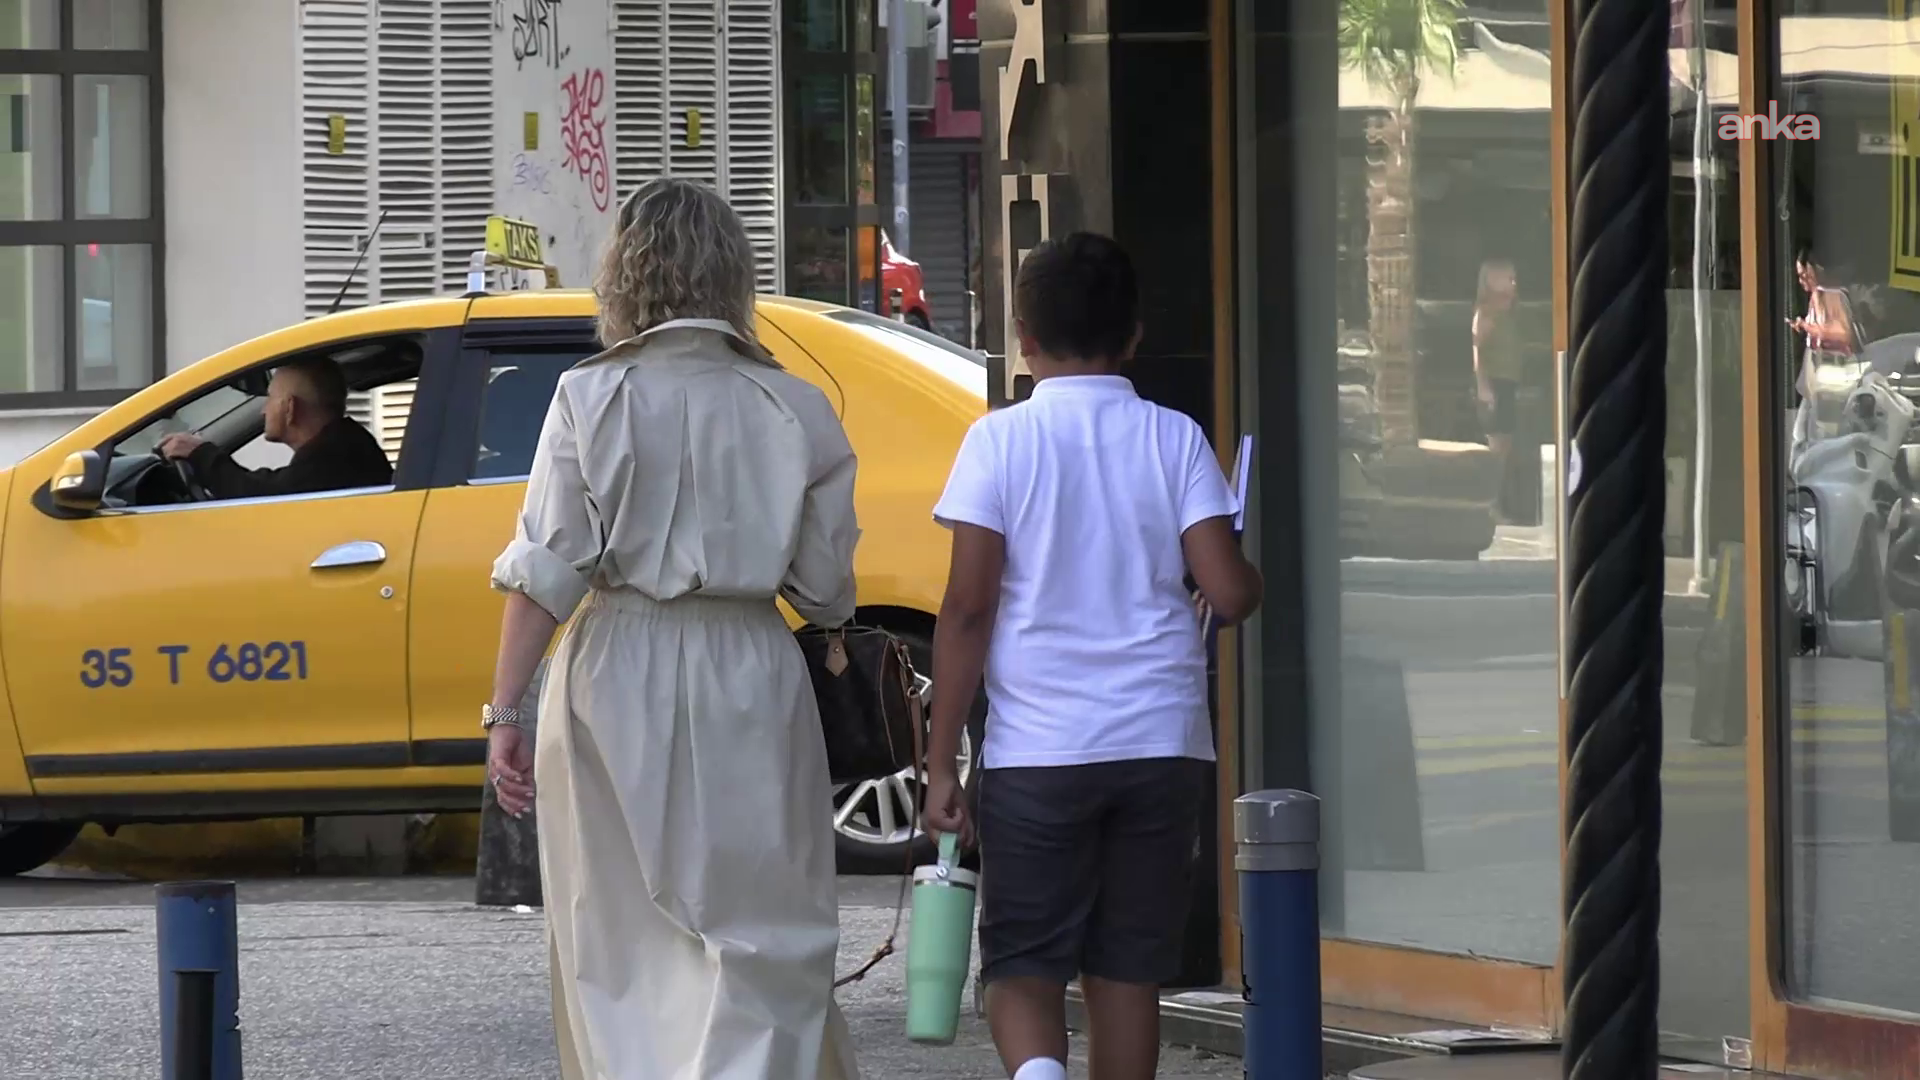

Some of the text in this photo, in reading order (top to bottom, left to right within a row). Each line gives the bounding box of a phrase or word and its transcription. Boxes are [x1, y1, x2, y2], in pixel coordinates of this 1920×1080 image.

[79, 640, 308, 688] 35 T 6821
